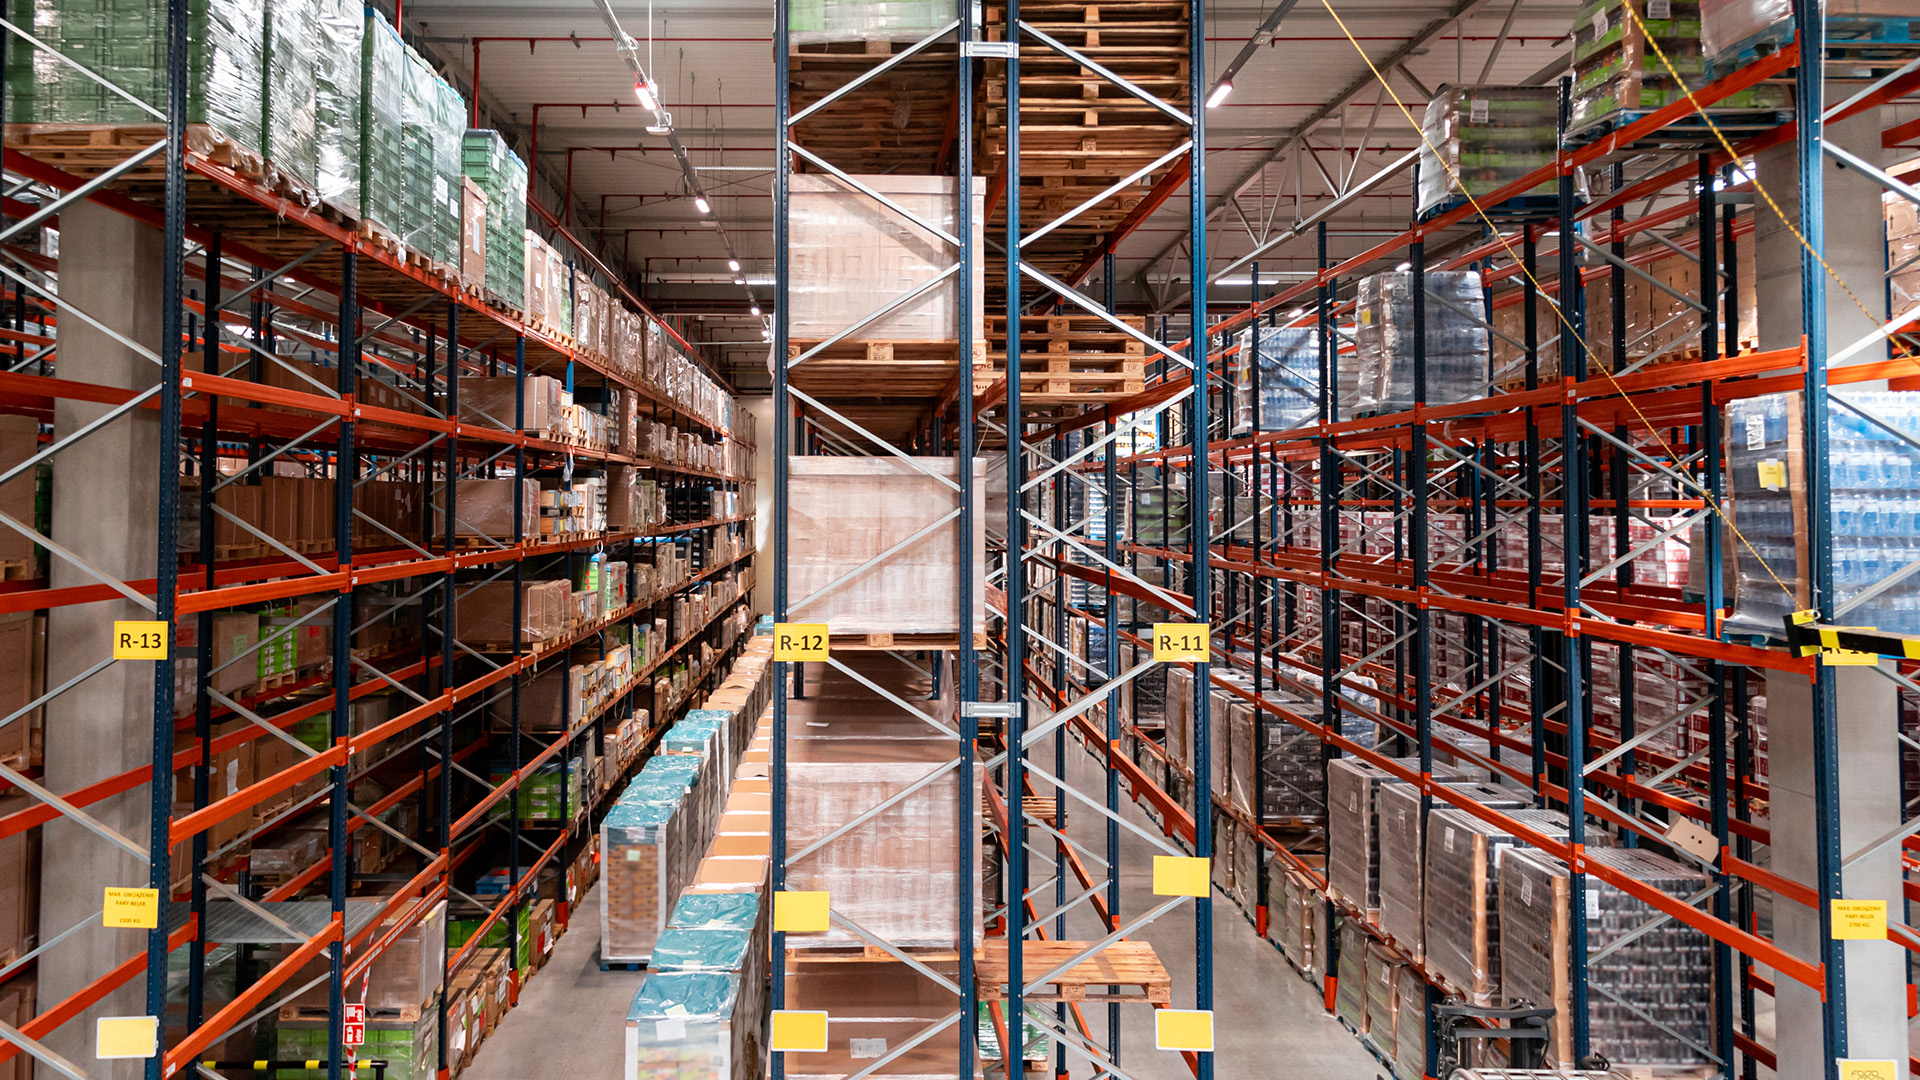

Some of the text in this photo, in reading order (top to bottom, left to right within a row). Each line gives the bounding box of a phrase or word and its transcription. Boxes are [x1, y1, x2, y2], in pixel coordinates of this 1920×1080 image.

[120, 633, 162, 649] R-13
[780, 635, 823, 651] R-12
[1160, 635, 1203, 651] R-11
